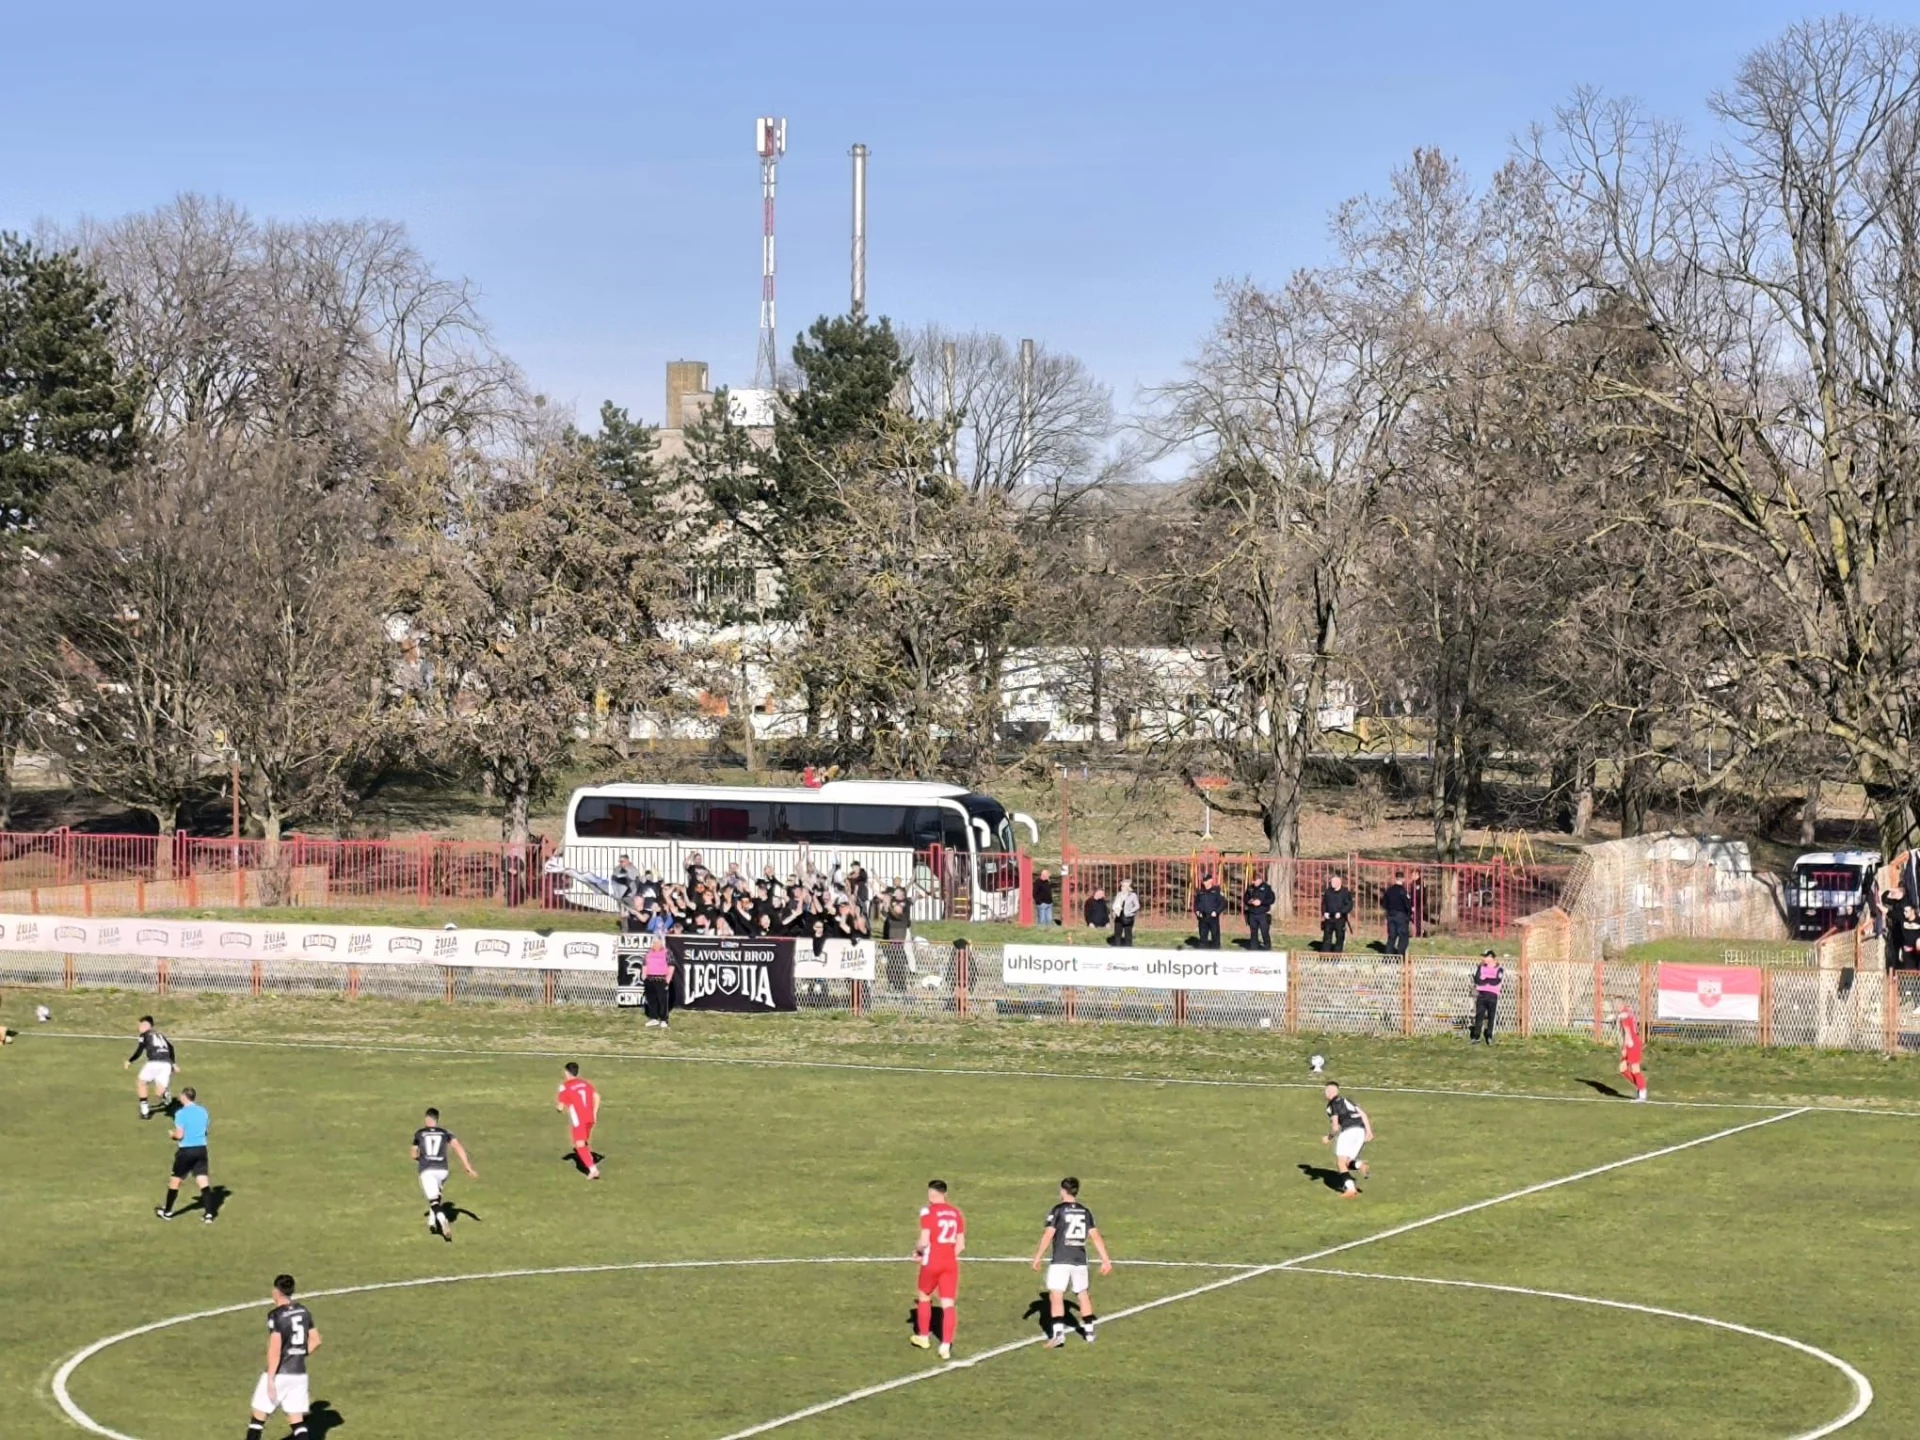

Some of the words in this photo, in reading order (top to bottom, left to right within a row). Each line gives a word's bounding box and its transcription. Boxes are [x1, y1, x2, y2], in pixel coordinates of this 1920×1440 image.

[264, 930, 286, 944] ŽUJA
[434, 935, 458, 950] ŽUJA
[684, 949, 742, 962] SLAVONSKI
[744, 950, 775, 962] BROD
[840, 947, 865, 962] ŽUJA
[1008, 955, 1078, 974] uhlsport
[1147, 960, 1219, 978] uhlsport
[424, 1135, 443, 1156] 17
[937, 1219, 958, 1244] 22
[1065, 1214, 1086, 1239] 25
[290, 1316, 305, 1345] 5
